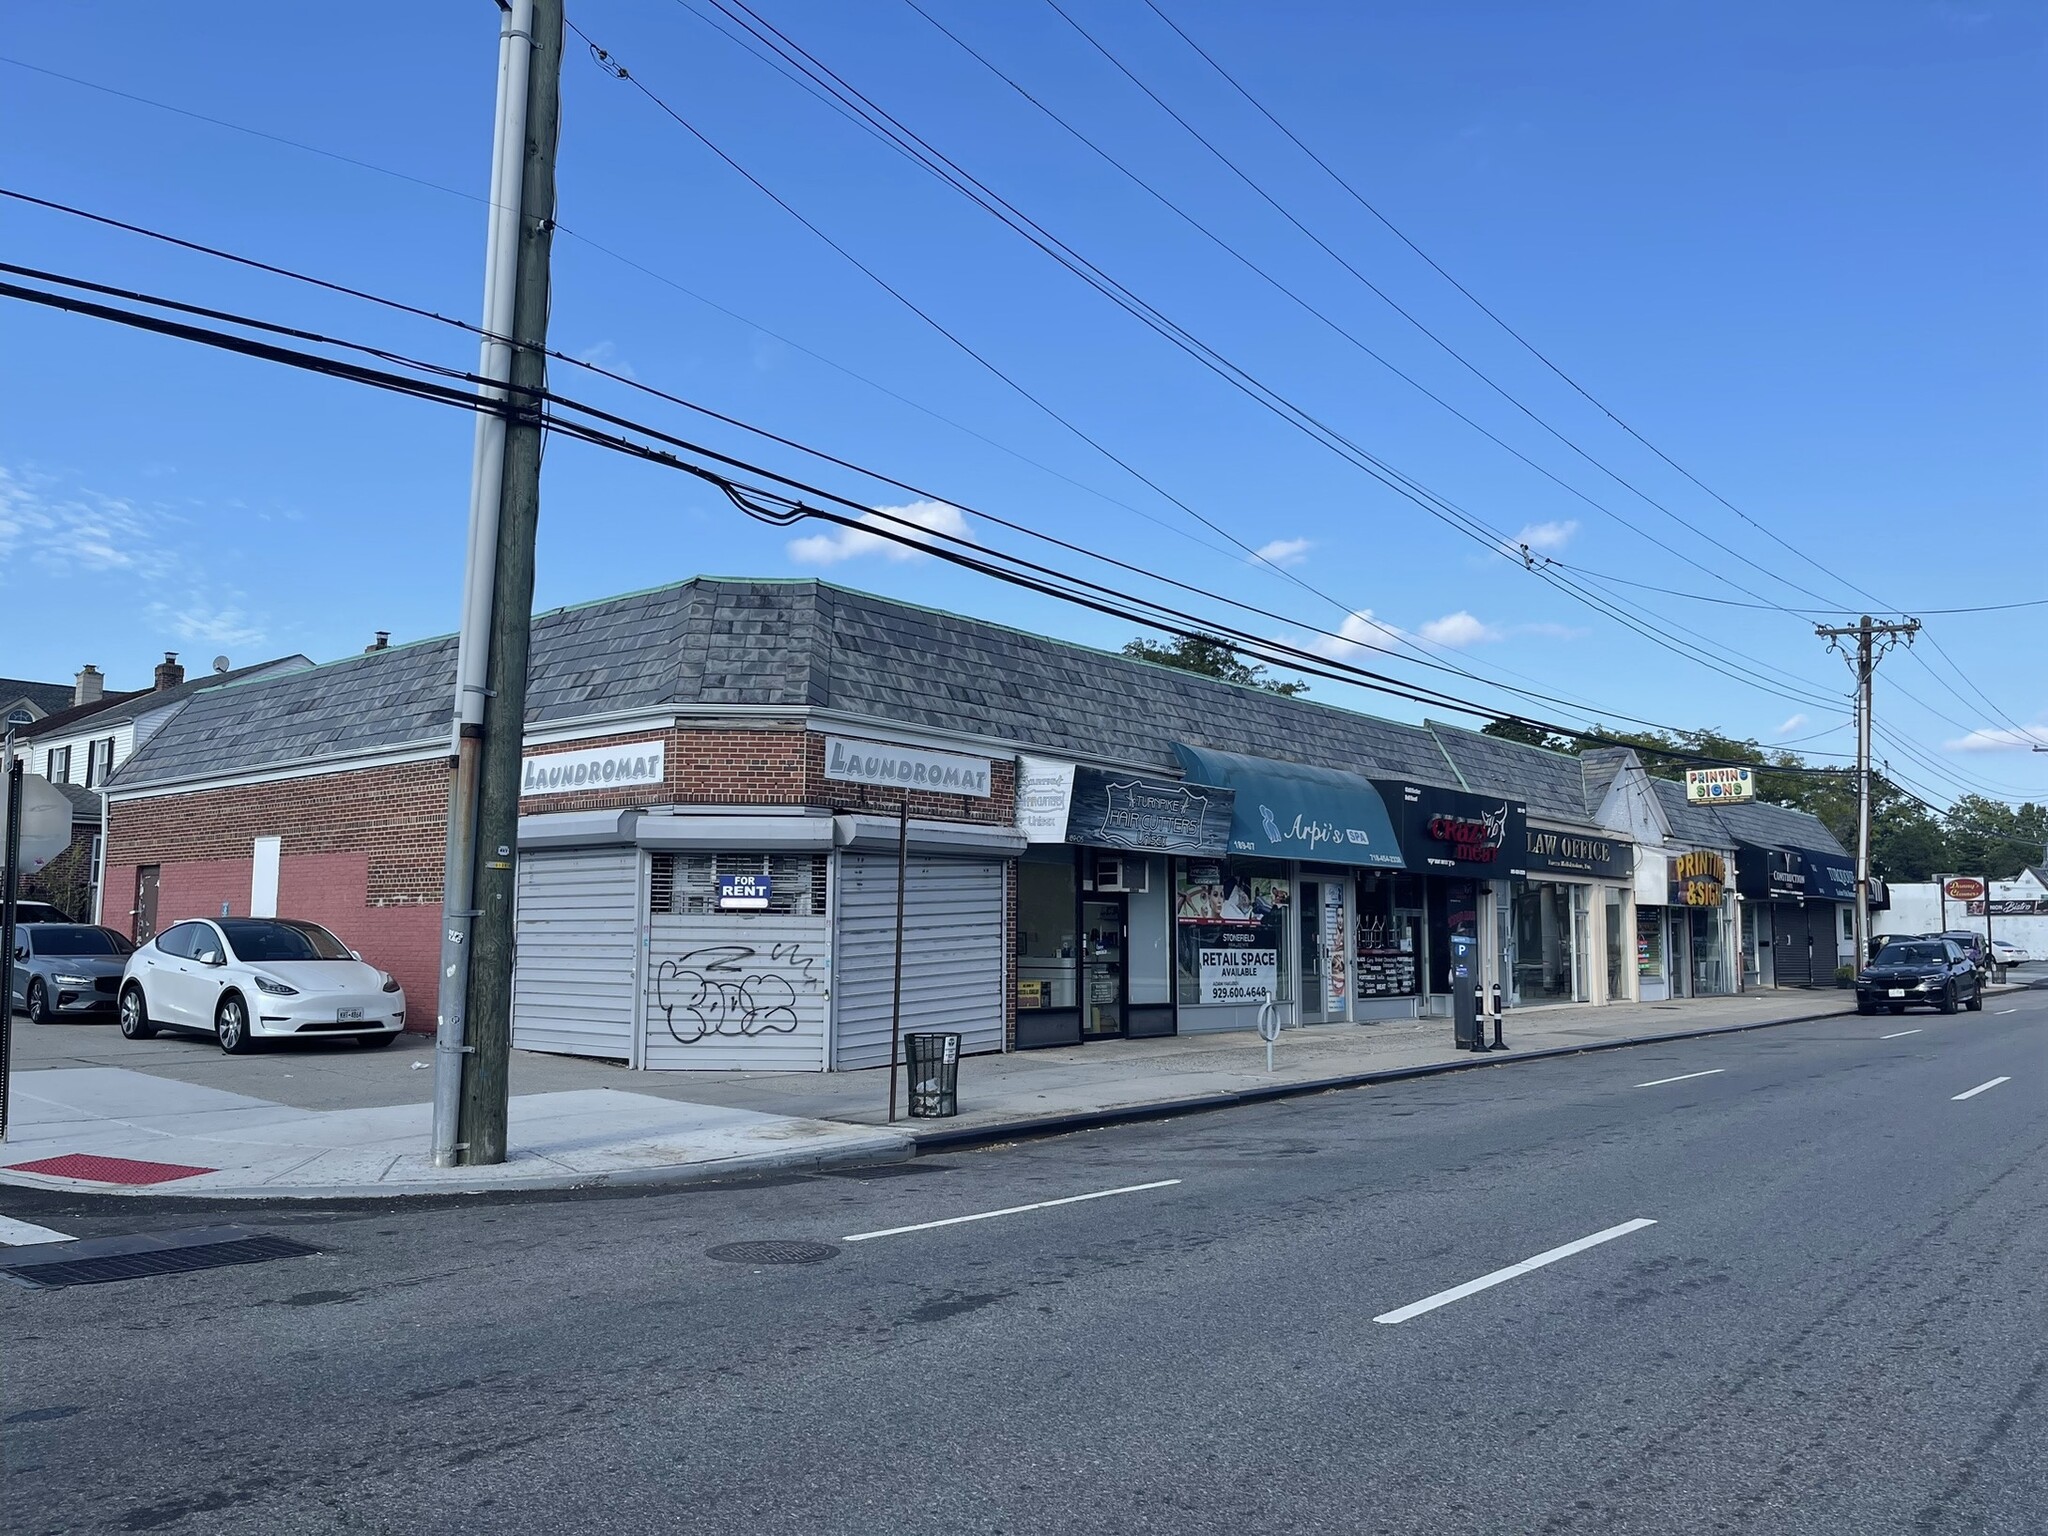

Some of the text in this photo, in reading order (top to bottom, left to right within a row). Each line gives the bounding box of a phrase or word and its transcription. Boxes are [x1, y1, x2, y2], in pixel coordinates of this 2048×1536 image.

[523, 755, 661, 790] LAUNDROMAT
[829, 742, 987, 792] LAUNDROMAT
[1690, 769, 1748, 784] PRINTING
[1696, 783, 1742, 797] SIGNS
[1136, 795, 1180, 812] TURNPIKE
[1108, 811, 1198, 836] HAIR CUTTERS
[1284, 814, 1366, 850] Arpi's SPA
[1526, 832, 1610, 862] LAW OFFICE
[734, 876, 755, 886] FOR
[722, 885, 767, 896] RENT
[2003, 901, 2032, 913] Bistro
[1458, 945, 1466, 955] P
[1202, 952, 1275, 966] RETAIL SPACE
[1221, 967, 1258, 977] AVAILABLE
[1212, 986, 1267, 999] 929.600.4648
